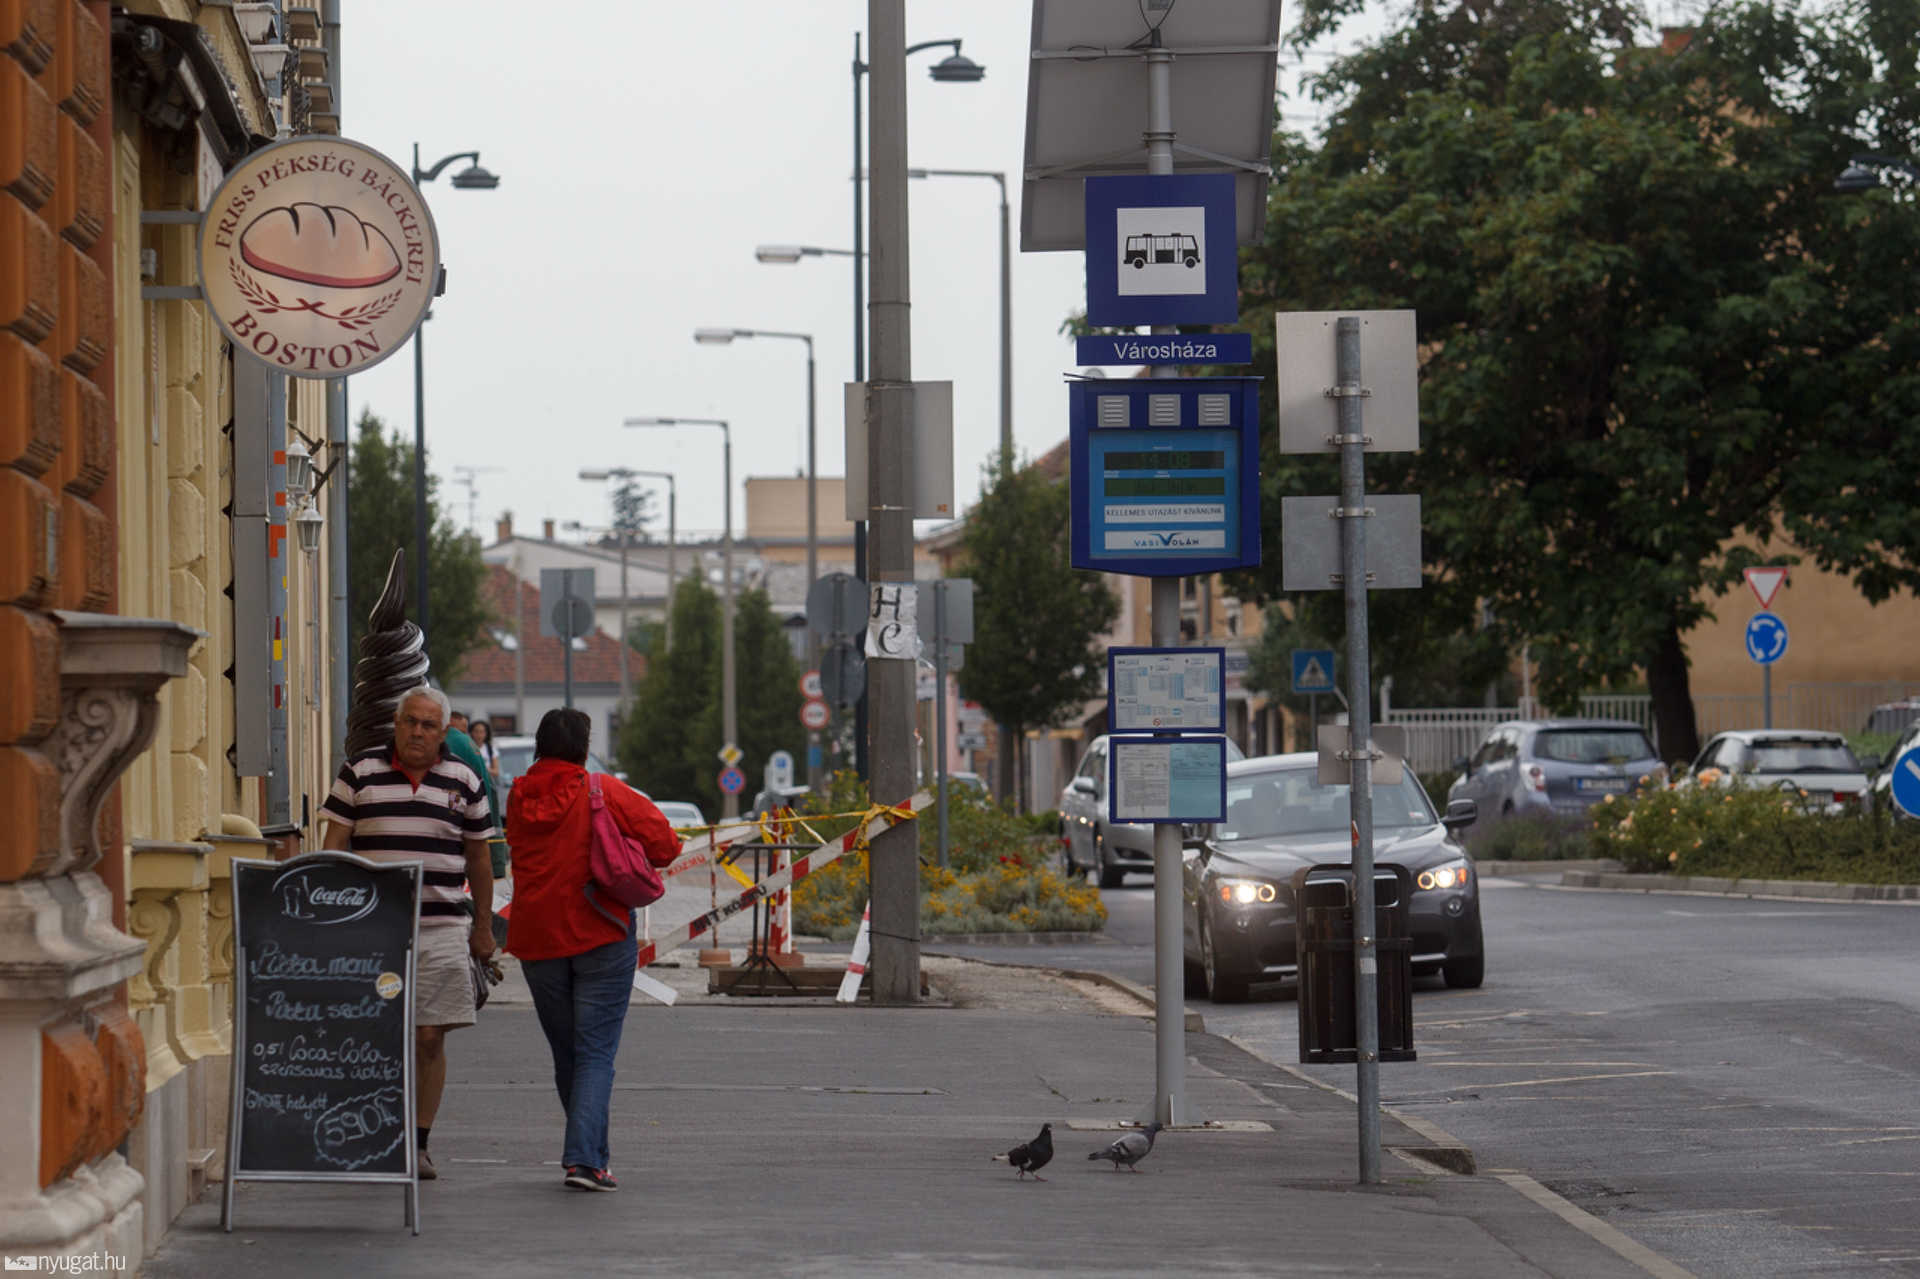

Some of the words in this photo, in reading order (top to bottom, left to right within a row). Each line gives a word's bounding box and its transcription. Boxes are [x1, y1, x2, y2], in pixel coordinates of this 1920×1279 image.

[215, 184, 257, 249] FRISS
[256, 152, 356, 189] PÉKSÉG
[360, 167, 424, 284] BÄCKEREI
[229, 311, 381, 370] BOSTON
[1113, 341, 1217, 359] Városháza
[1106, 508, 1145, 517] KELLEMES
[872, 586, 901, 621] H
